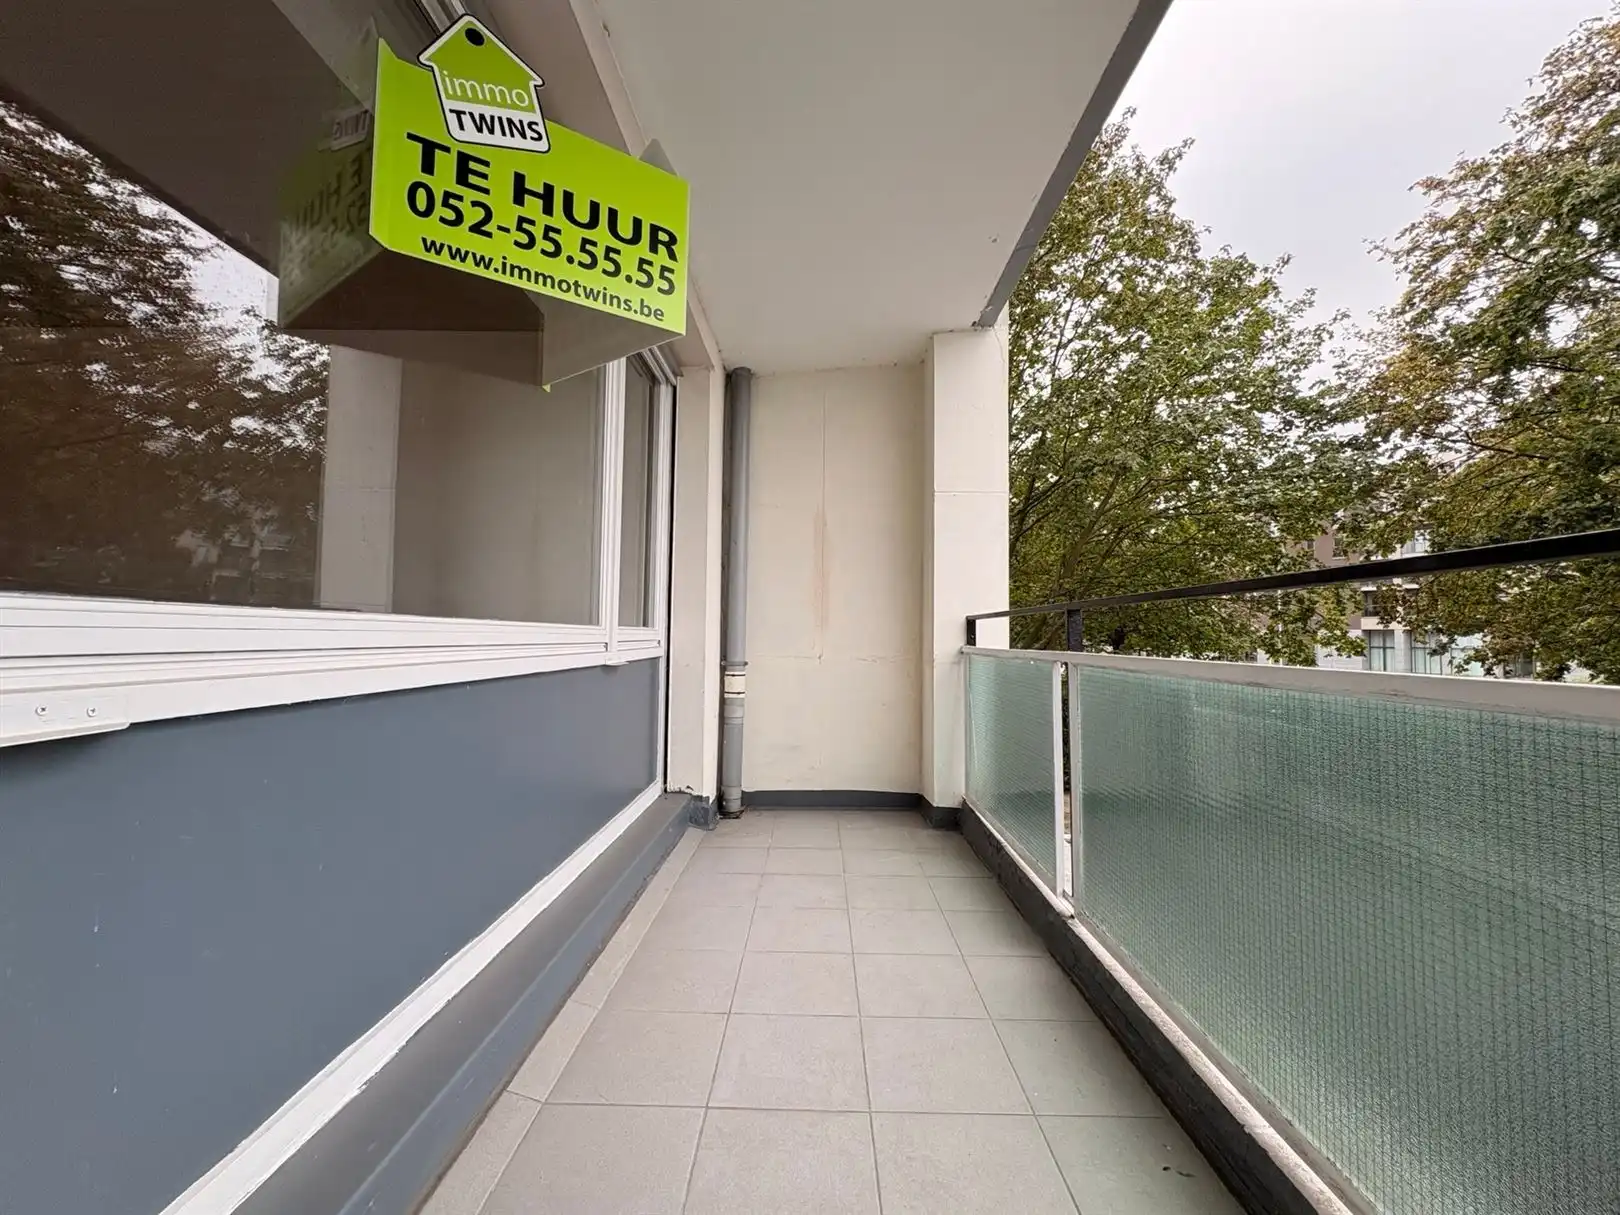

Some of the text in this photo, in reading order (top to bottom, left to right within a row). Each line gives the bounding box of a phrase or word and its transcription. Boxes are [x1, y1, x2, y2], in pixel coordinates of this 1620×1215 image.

[443, 70, 529, 107] immo
[449, 108, 543, 142] TWINS
[406, 132, 491, 196] TE
[512, 170, 679, 263] HUUR
[406, 180, 676, 296] 052-55.55.55
[421, 236, 665, 322] www.immotwins.be
